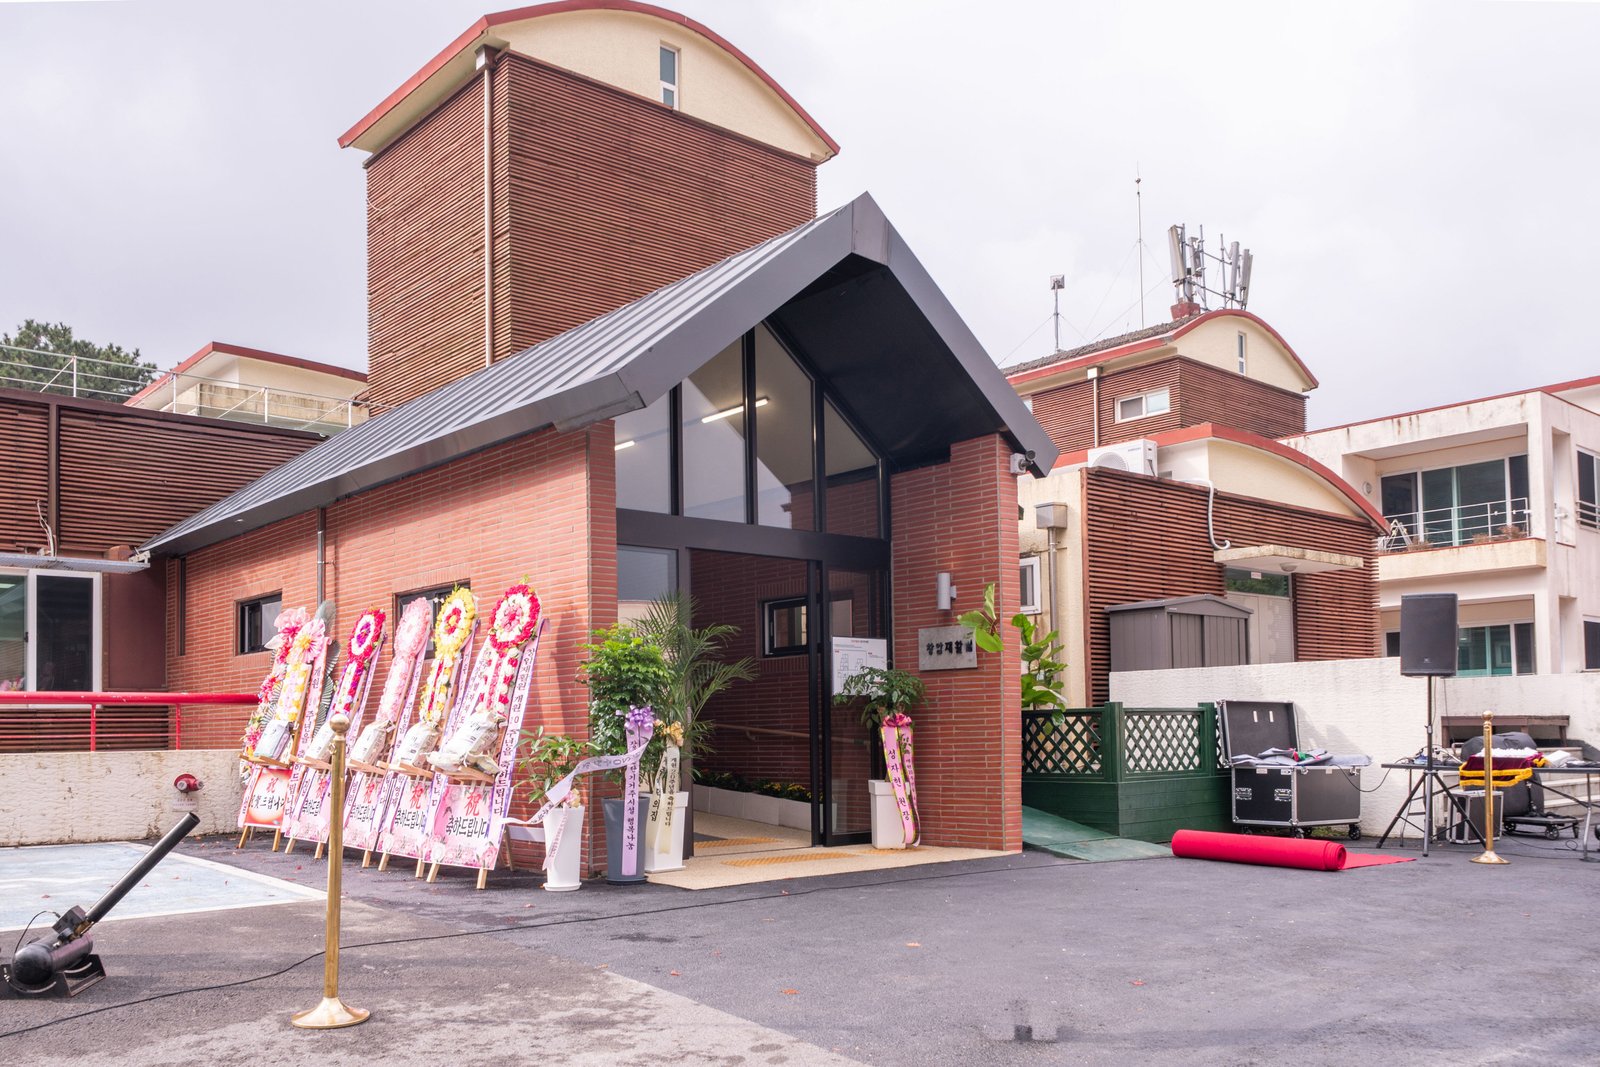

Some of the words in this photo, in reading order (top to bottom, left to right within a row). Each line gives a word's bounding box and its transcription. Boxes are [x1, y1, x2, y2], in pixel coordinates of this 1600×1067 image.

[410, 783, 424, 809] 祝
[494, 761, 510, 816] 축하드립니다
[464, 791, 482, 816] 祝
[898, 797, 910, 821] 원장
[626, 818, 635, 850] 행복나눔
